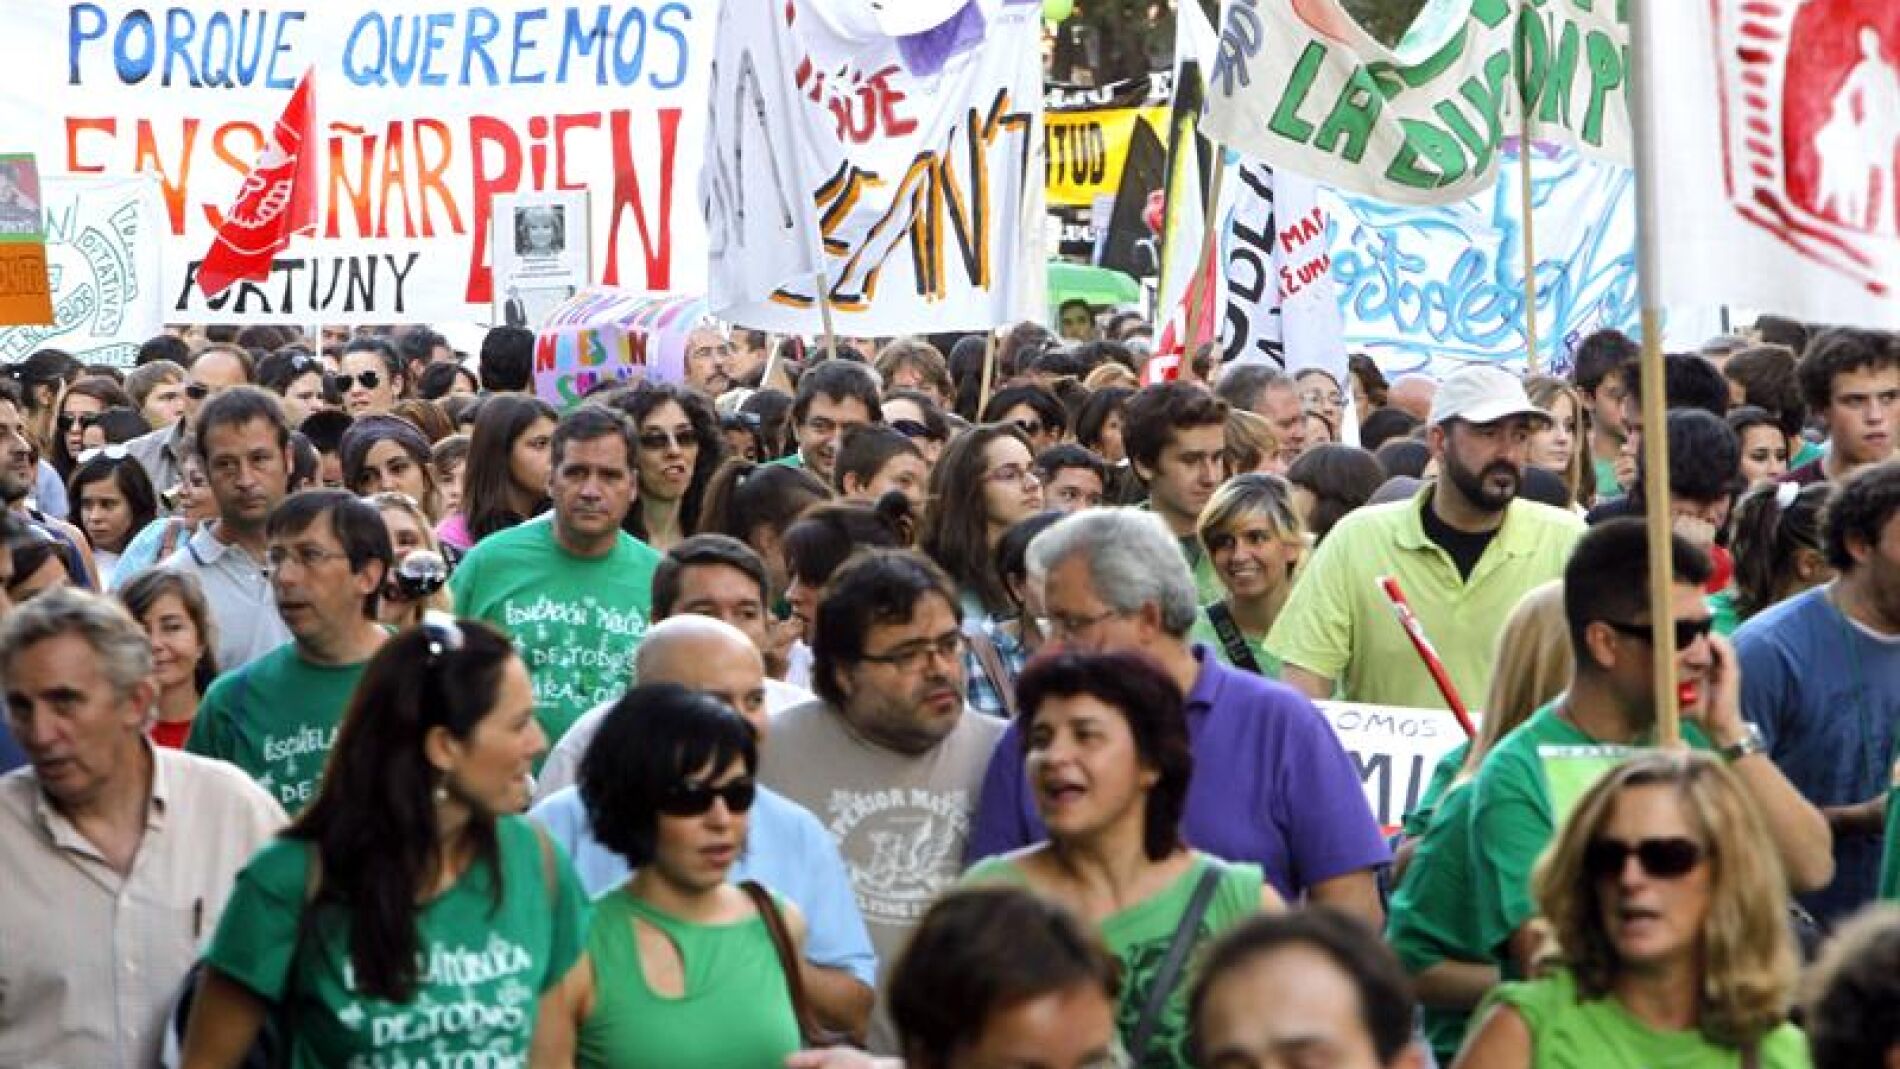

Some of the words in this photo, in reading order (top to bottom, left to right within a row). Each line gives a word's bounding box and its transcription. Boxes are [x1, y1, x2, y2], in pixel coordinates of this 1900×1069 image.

[68, 2, 306, 89] PORQUE
[341, 2, 693, 90] QUEREMOS
[65, 115, 467, 239] ENSÑAR
[1336, 709, 1438, 738] OMOS
